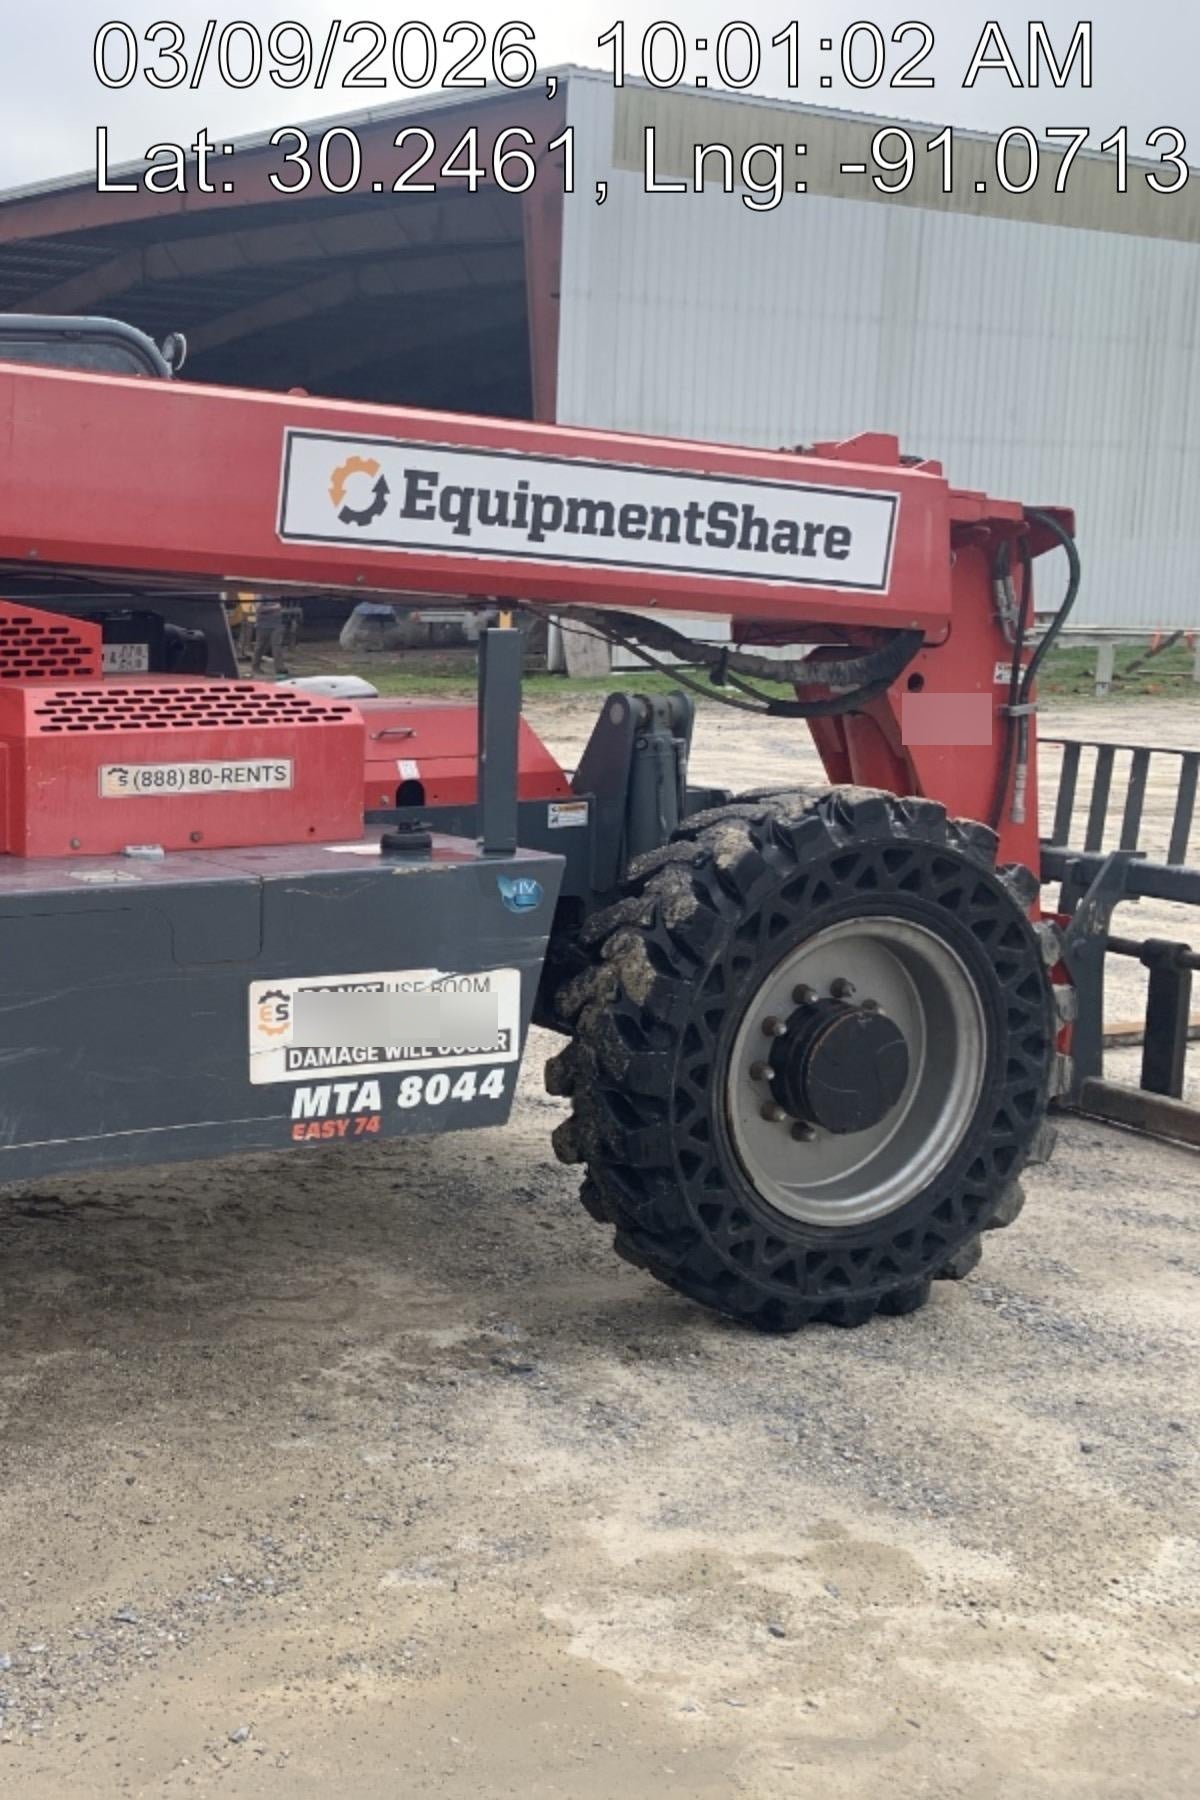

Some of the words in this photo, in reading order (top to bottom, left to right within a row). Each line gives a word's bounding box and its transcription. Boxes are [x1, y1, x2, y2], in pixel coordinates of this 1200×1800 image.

[400, 468, 852, 560] EquipmentShare
[288, 1046, 379, 1069] DAMAGE
[291, 1080, 382, 1120] MTA
[397, 1068, 505, 1109] 8044
[291, 1120, 349, 1141] EASY
[353, 1115, 382, 1135] 74
